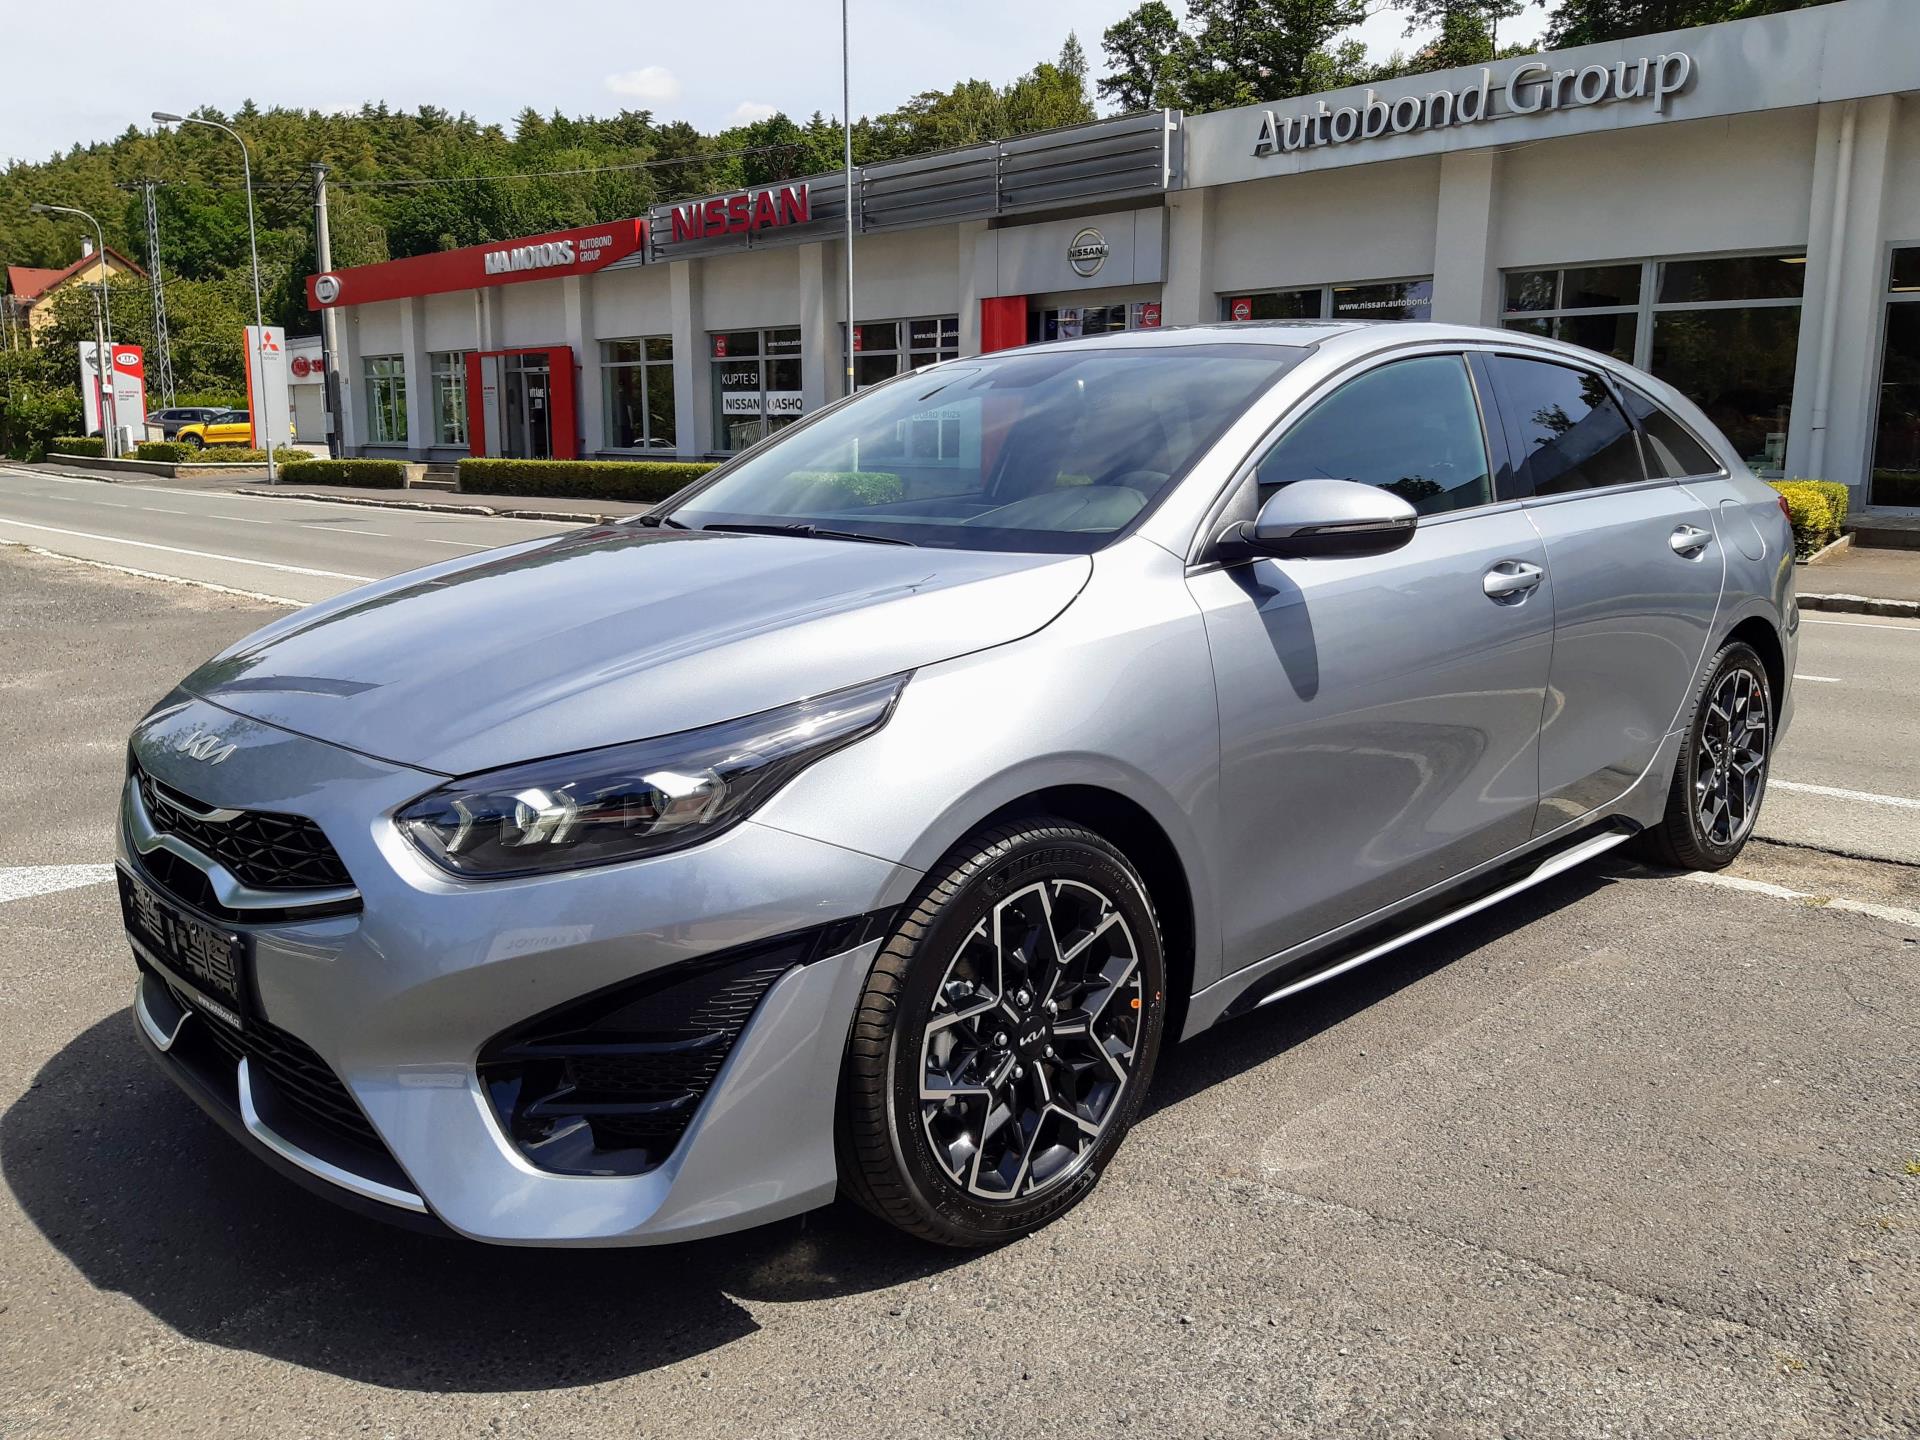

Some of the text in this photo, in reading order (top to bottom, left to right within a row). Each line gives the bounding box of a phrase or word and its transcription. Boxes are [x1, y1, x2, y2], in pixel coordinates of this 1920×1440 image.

[1250, 51, 1691, 156] Autobond Group
[671, 184, 810, 242] NISSAN
[579, 235, 613, 251] AUTOBOND
[511, 240, 576, 271] MOTORS
[579, 249, 601, 262] GROUP
[1069, 246, 1104, 258] NISSAN
[721, 373, 758, 385] KUPTE SI
[725, 398, 760, 410] NISSAN
